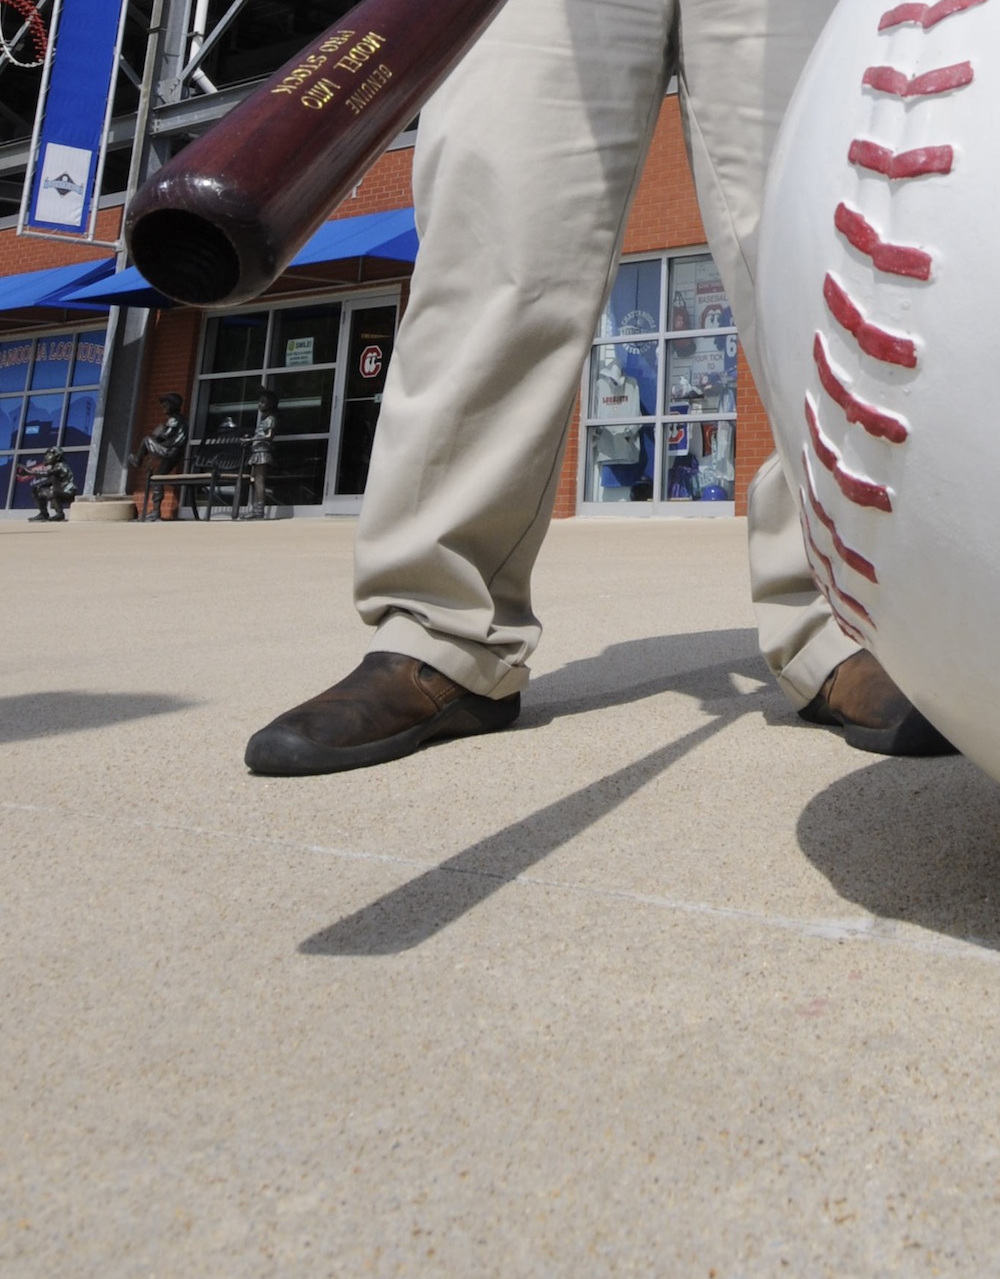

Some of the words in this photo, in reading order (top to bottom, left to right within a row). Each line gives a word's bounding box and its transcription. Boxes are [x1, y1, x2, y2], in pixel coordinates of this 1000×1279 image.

[319, 29, 356, 53] PRO
[333, 31, 387, 74] MODEL
[270, 54, 327, 95] STOCK
[345, 63, 393, 115] GENUINE
